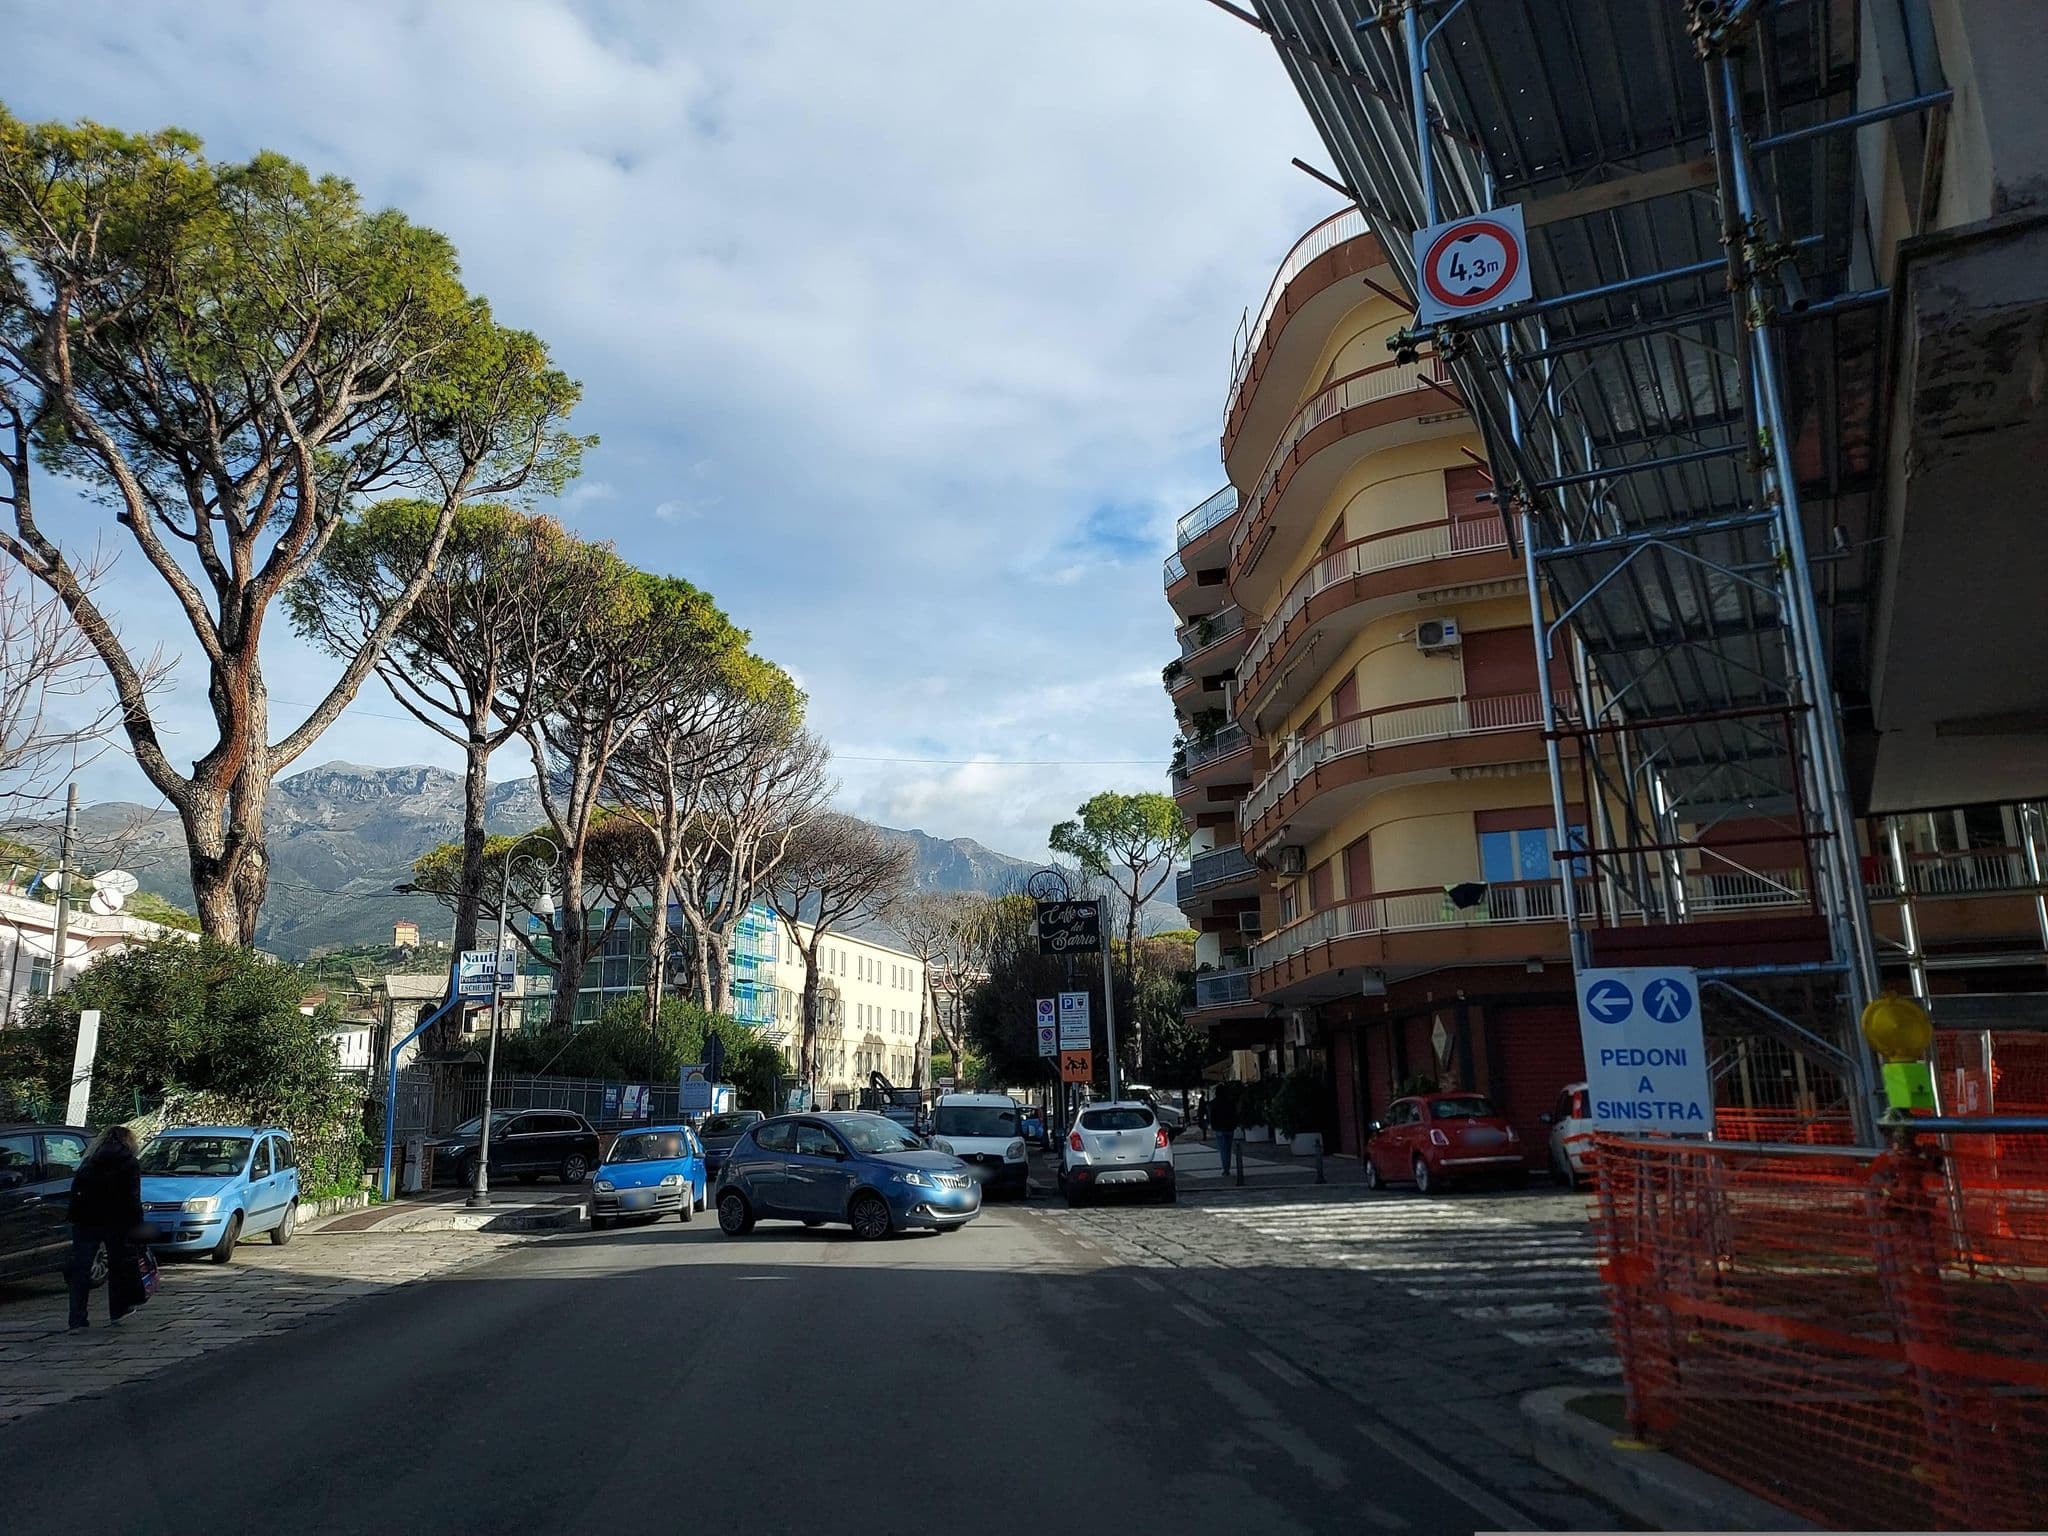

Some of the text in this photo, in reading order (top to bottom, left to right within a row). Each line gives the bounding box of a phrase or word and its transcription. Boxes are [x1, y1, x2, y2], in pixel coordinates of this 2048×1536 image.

[1041, 930, 1096, 951] Barrio
[463, 952, 513, 963] Nautia
[1064, 999, 1072, 1009] P
[1601, 1048, 1687, 1067] PEDONI
[1637, 1076, 1655, 1094] A
[1596, 1101, 1704, 1121] SINISTRA
